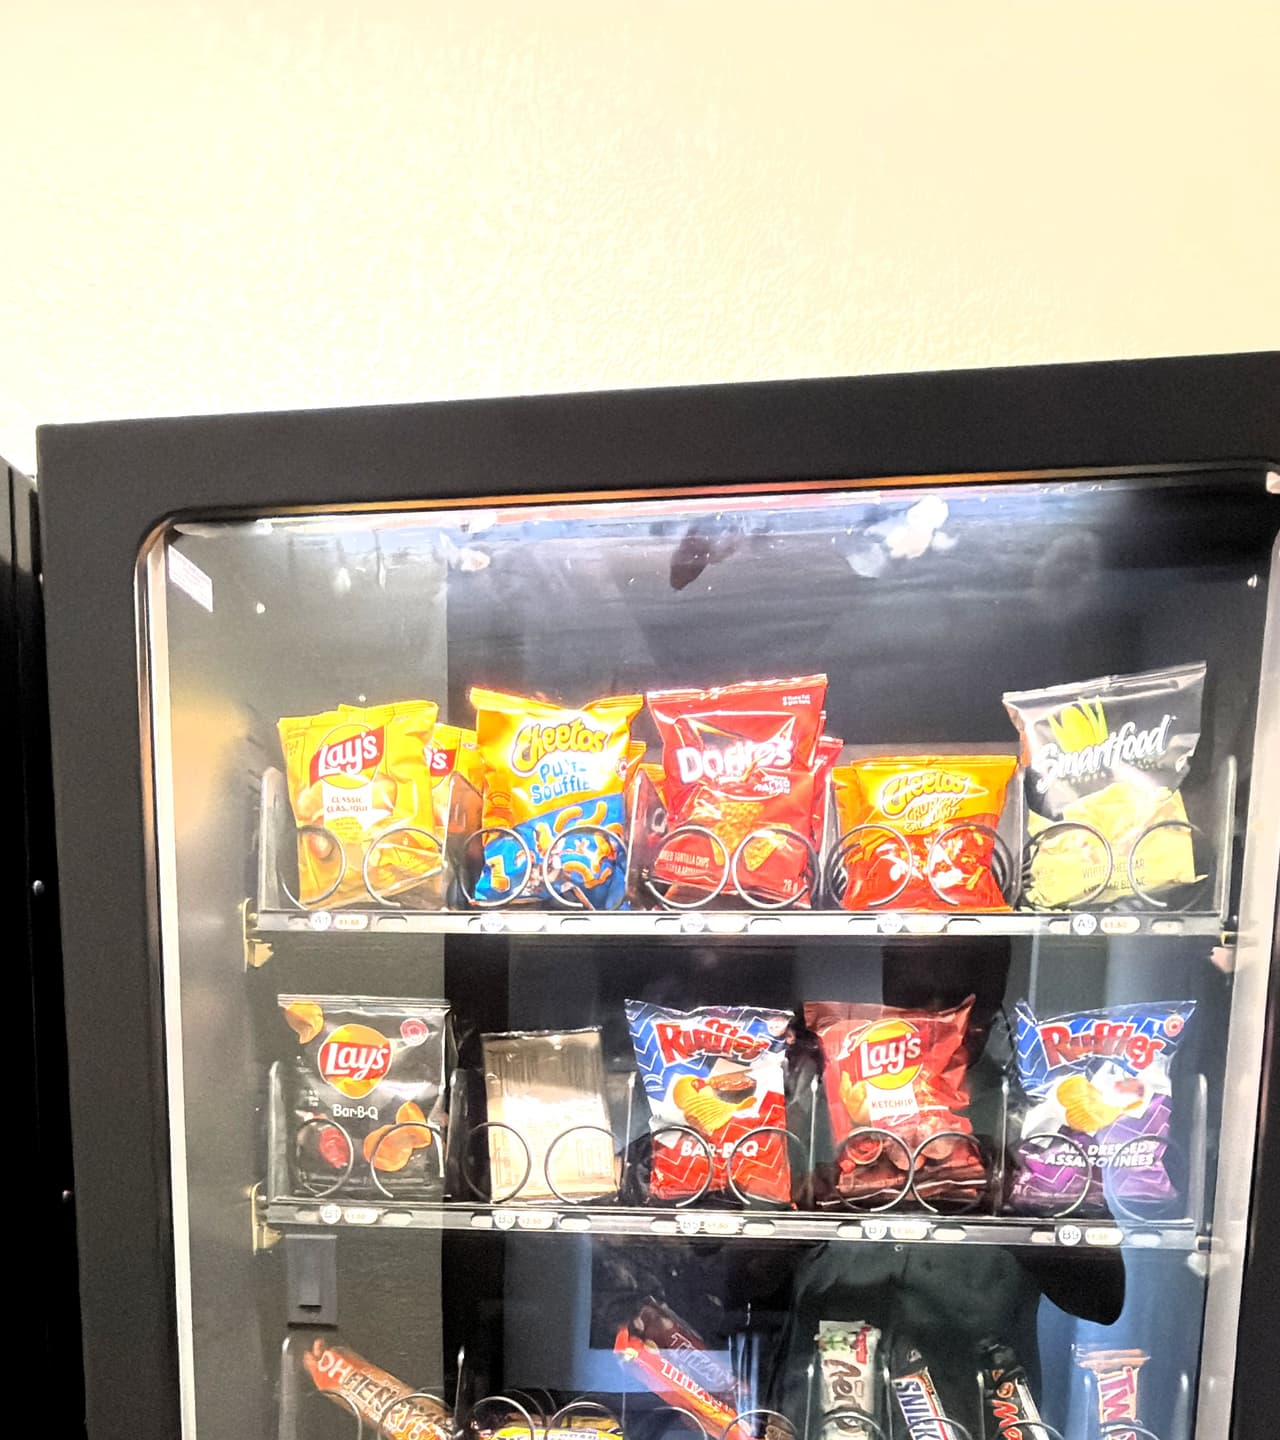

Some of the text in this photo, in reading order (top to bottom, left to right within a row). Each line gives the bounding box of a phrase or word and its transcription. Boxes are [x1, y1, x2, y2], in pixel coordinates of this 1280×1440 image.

[318, 730, 380, 777] Lay's
[513, 717, 609, 772] Cheetos
[676, 737, 795, 784] Doritos
[1036, 714, 1172, 794] Smartfood
[882, 769, 968, 818] Cheetos
[325, 1042, 389, 1080] Lay's
[656, 1018, 770, 1065] Ruffles
[860, 1032, 922, 1077] Lay's
[1040, 1021, 1166, 1070] Ruffles
[871, 1098, 914, 1110] KETCHUP
[317, 1351, 350, 1383] OH
